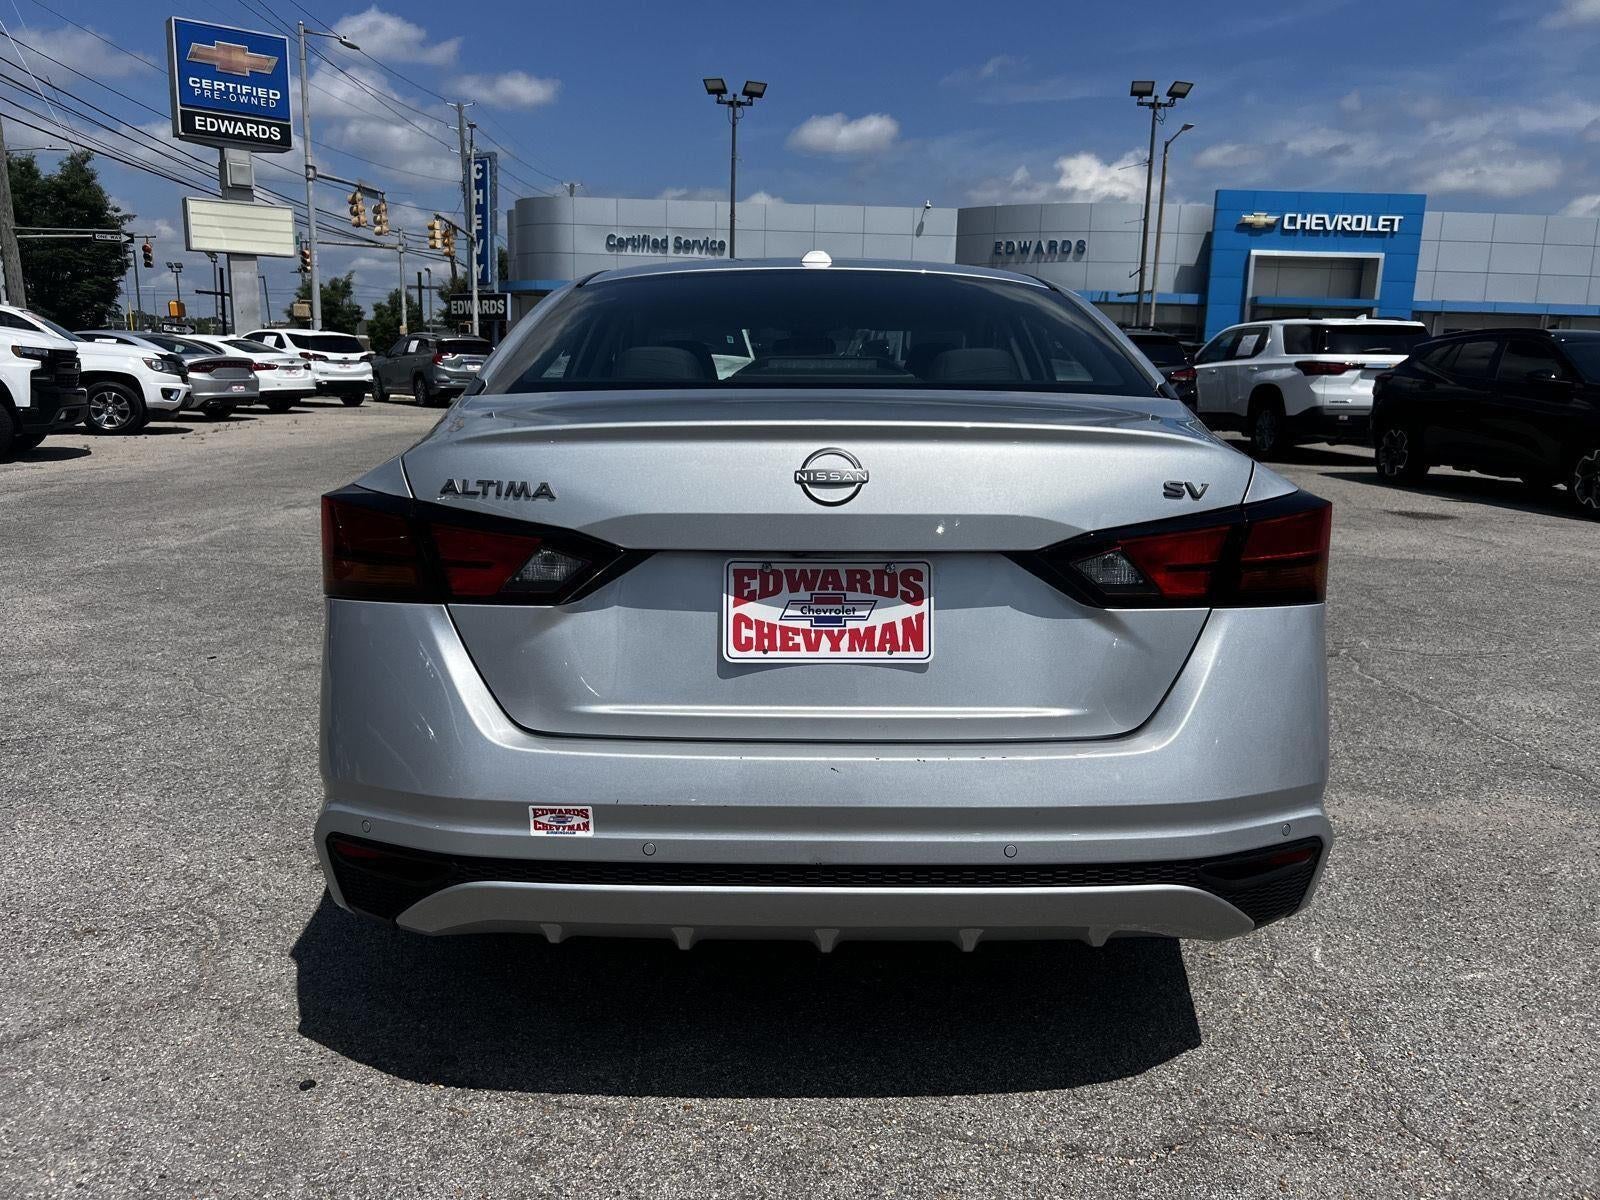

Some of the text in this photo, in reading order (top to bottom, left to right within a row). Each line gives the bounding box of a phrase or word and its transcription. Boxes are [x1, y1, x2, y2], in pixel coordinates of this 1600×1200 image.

[188, 77, 281, 100] CERTIFIED
[194, 88, 277, 108] PRE-OWNED
[195, 116, 281, 140] EDWARDS
[474, 163, 484, 280] CHEVY
[1283, 213, 1404, 232] CHEVROLET
[605, 233, 726, 253] Certified Service
[994, 239, 1086, 255] EDWARDS
[450, 299, 505, 315] EDWARDS
[796, 472, 868, 481] NISSAN
[440, 478, 557, 500] ALTIMA
[1163, 480, 1209, 501] SV
[733, 568, 925, 608] EDWARDS
[800, 606, 857, 616] Chevrolet
[733, 611, 925, 652] CHEVYMAN
[532, 808, 590, 820] EDWARDS
[533, 819, 590, 832] CHEVYMAN
